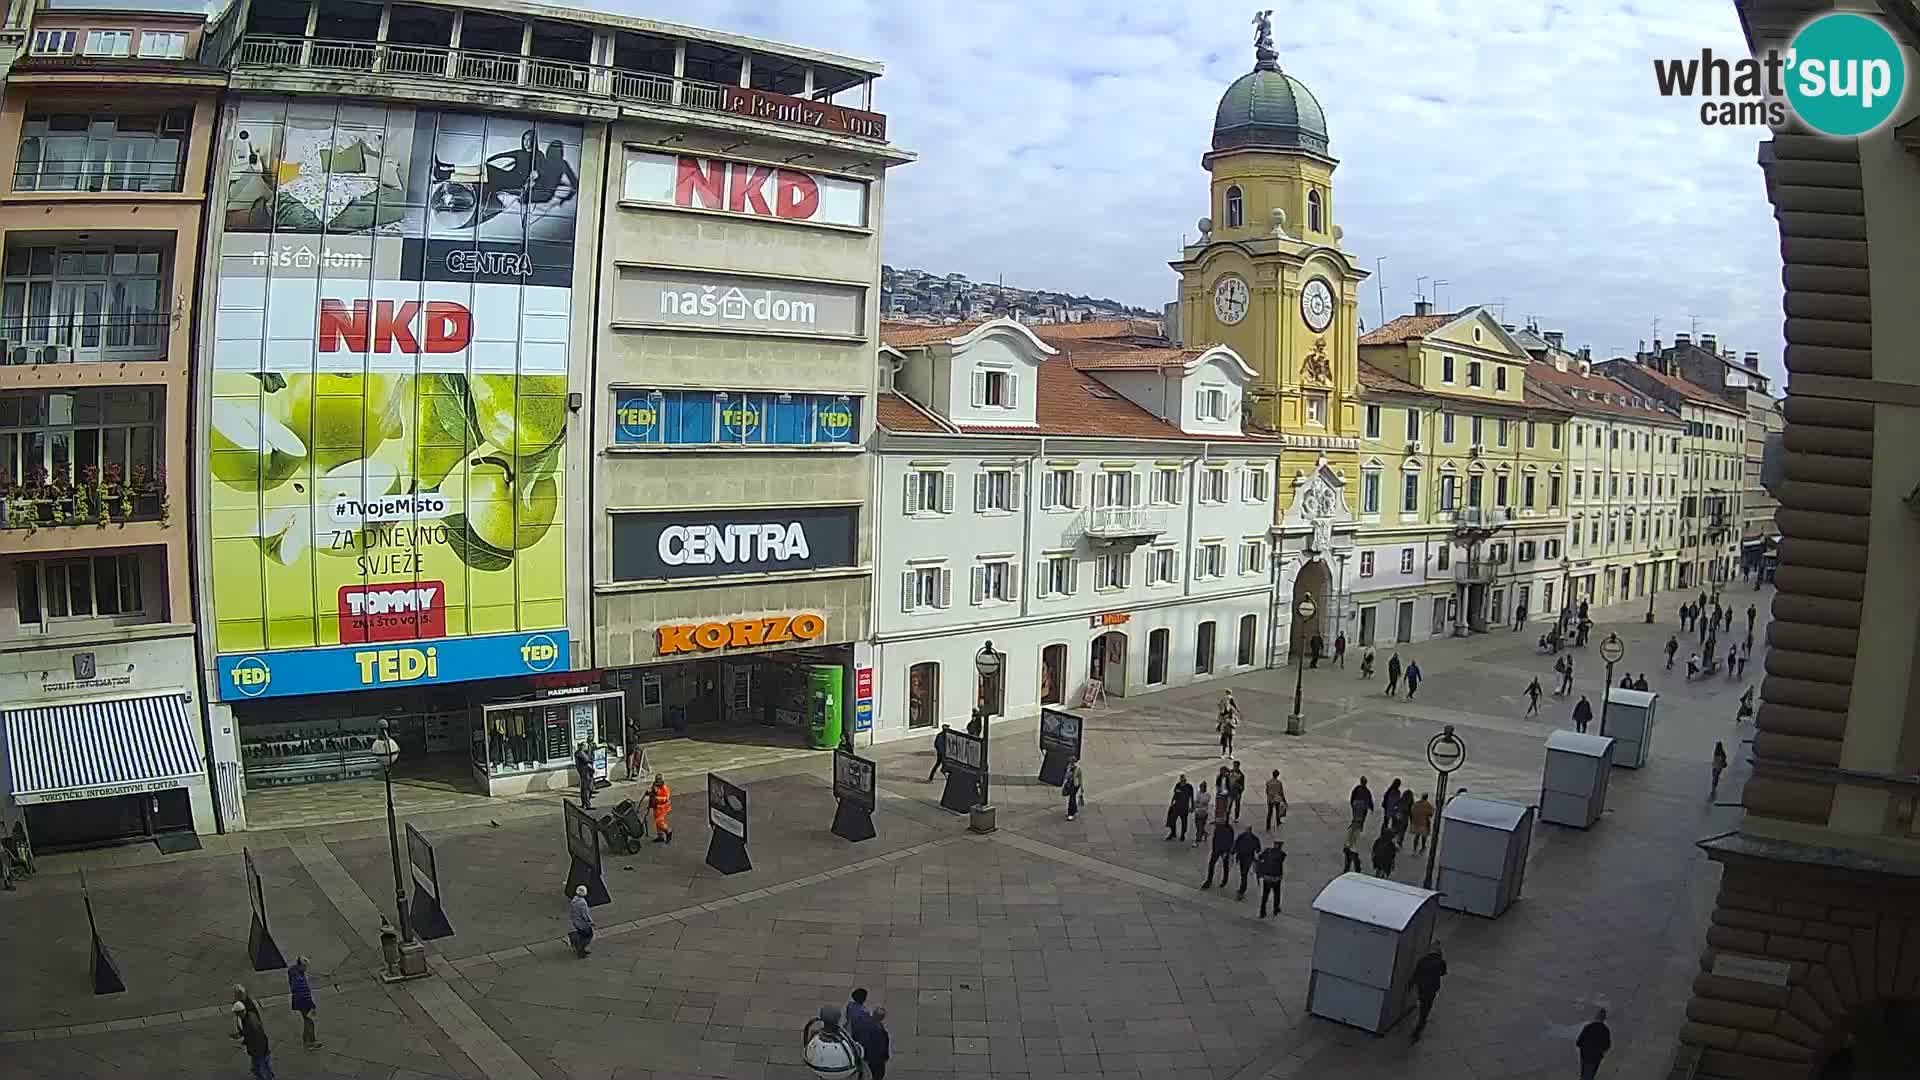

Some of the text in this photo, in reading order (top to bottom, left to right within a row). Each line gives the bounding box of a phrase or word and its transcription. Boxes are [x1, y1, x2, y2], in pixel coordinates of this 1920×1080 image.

[722, 88, 744, 114] Le
[675, 157, 820, 220] NKD
[446, 250, 533, 277] CENTRA
[660, 285, 816, 324] naš dom
[318, 298, 474, 354] NKD
[617, 407, 657, 426] TEDi
[722, 409, 759, 427] TEDi
[819, 411, 852, 428] TEDi
[335, 499, 444, 518] #TvojeMisto
[331, 525, 449, 550] ZA DNEVNO
[657, 521, 810, 566] CENTRA
[356, 549, 424, 576] SVJEŽE
[346, 587, 438, 616] TOMMY
[656, 613, 825, 656] KORZO
[355, 646, 438, 684] TEDi
[520, 642, 558, 662] TEDi
[232, 666, 271, 686] TEDi
